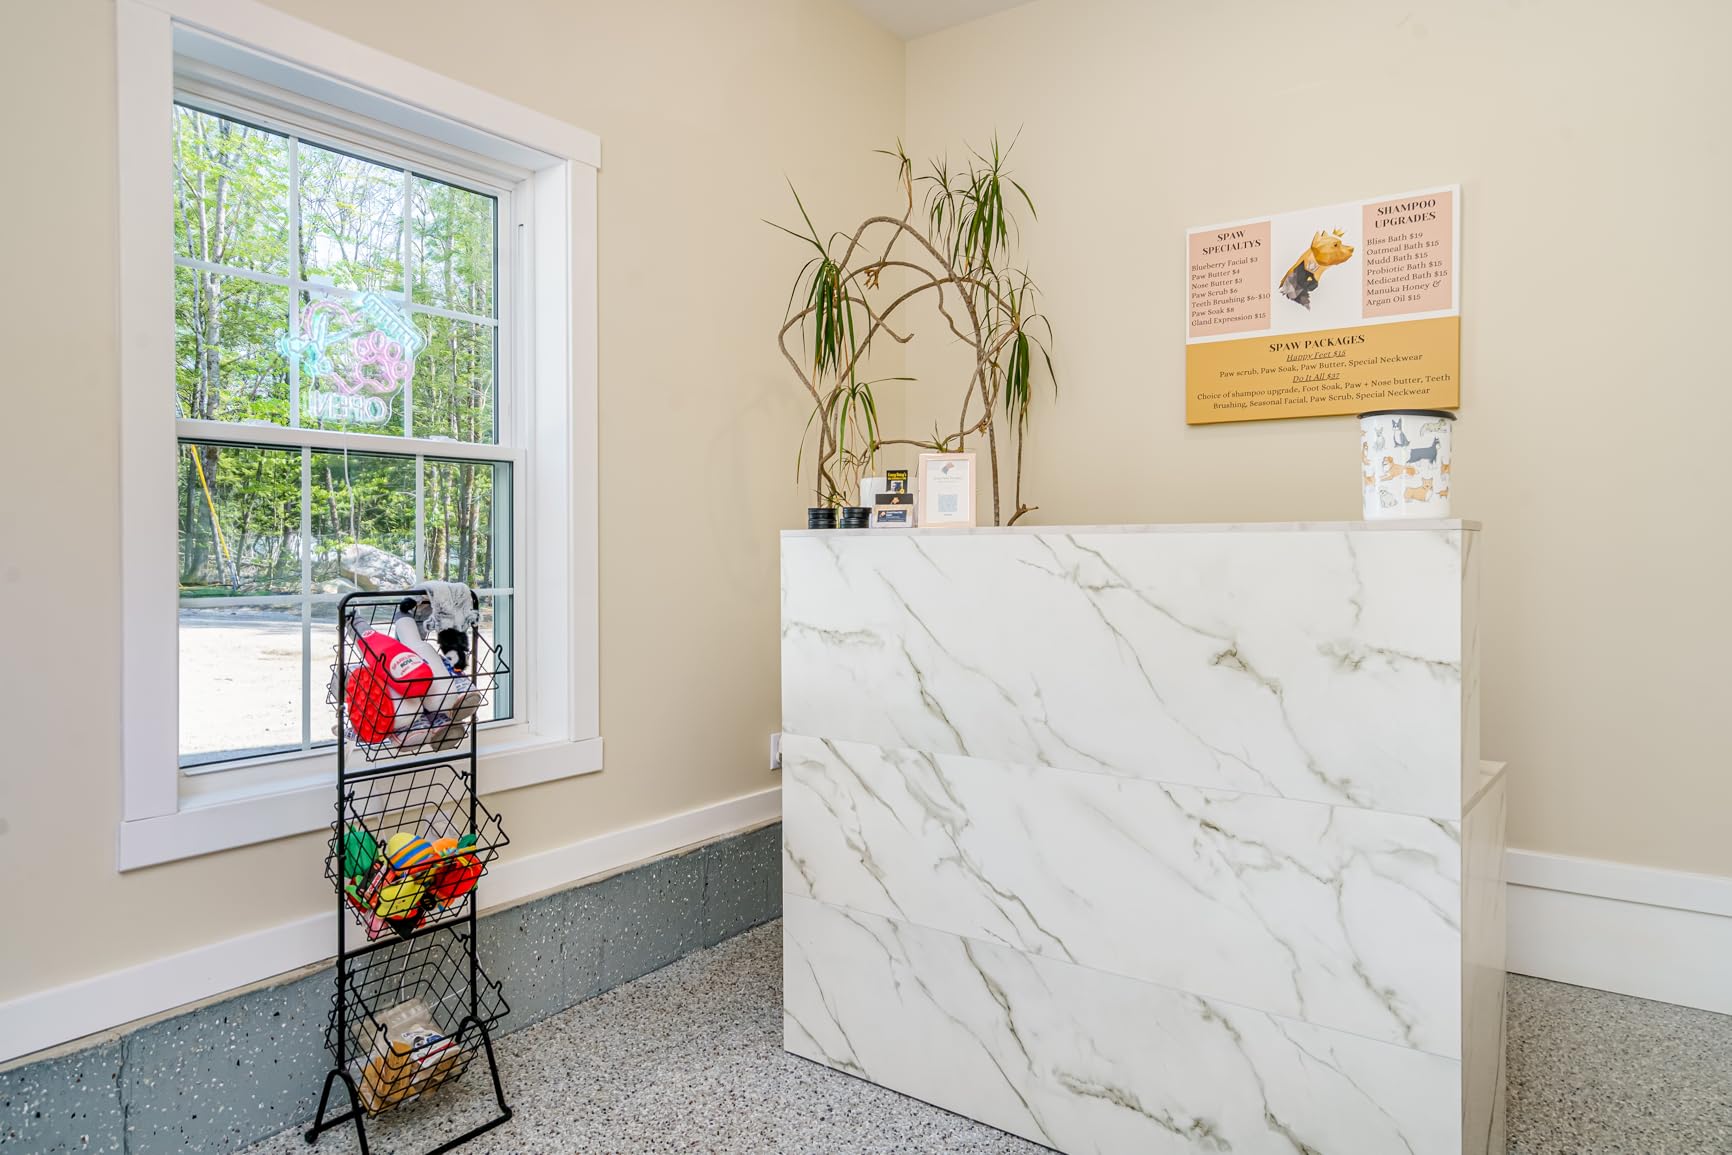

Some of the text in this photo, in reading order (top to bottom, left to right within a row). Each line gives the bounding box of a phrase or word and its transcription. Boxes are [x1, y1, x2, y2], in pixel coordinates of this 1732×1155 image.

[1377, 199, 1436, 216] SHAMPOO
[1375, 212, 1436, 228] UPGRADES
[1217, 230, 1246, 242] SPAW
[1388, 234, 1407, 243] Bath
[1202, 239, 1261, 255] SPECIALTYS
[1367, 246, 1402, 256] Oatmeal
[1404, 242, 1423, 250] Bath
[1192, 262, 1226, 271] Blueberry
[1228, 257, 1248, 266] Facial
[1367, 256, 1390, 265] Mudd
[1393, 254, 1412, 262] Bath
[1367, 265, 1404, 275] Probiotic
[1407, 262, 1426, 270] Bath
[1367, 275, 1410, 285] Medicated
[1412, 272, 1431, 280] Bath
[1208, 288, 1228, 296] Scrub
[1367, 286, 1400, 296] Manuka
[1402, 283, 1430, 293] Honey
[1213, 296, 1245, 305] Brushing
[1366, 298, 1391, 306] Argan
[1192, 318, 1212, 326] Gland
[1214, 315, 1252, 324] Expression
[1270, 334, 1366, 352] SPAW PACKAGES
[1236, 368, 1259, 376] scrub,
[1279, 365, 1299, 373] Soak,
[1319, 361, 1347, 370] Butter,
[1349, 358, 1377, 367] Special
[1380, 354, 1423, 364] Neckwear
[1232, 390, 1265, 398] shampoo
[1267, 387, 1300, 396] upgrade,
[1393, 376, 1423, 384] butter,
[1426, 374, 1451, 382] Teeth
[1329, 393, 1353, 401] Scrub,
[1356, 390, 1385, 400] Special
[1388, 387, 1430, 397] Neckwear
